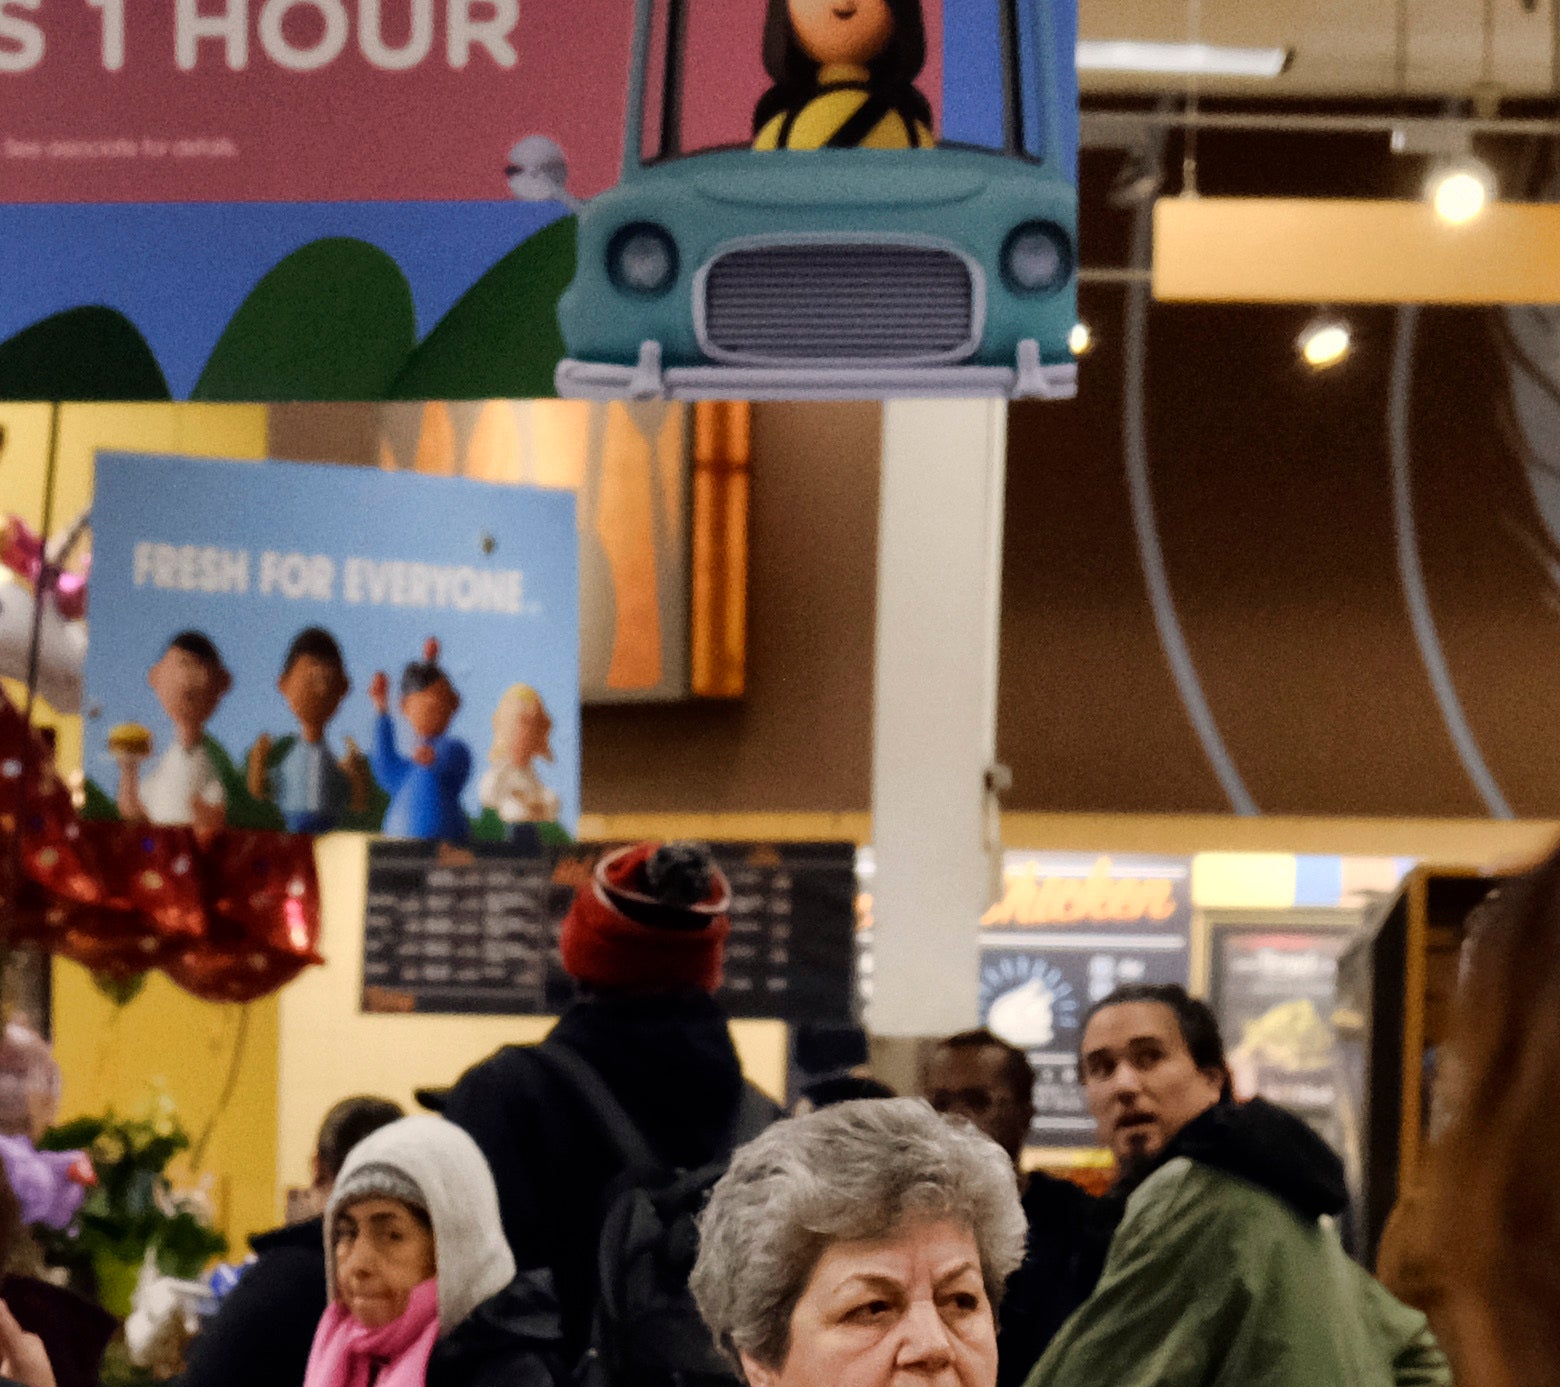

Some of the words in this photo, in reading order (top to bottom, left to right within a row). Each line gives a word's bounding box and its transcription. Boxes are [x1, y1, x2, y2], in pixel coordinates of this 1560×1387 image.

[92, 0, 125, 71] 1
[174, 0, 520, 70] HOUR
[133, 540, 250, 594] FRESH
[258, 549, 336, 600] FOR
